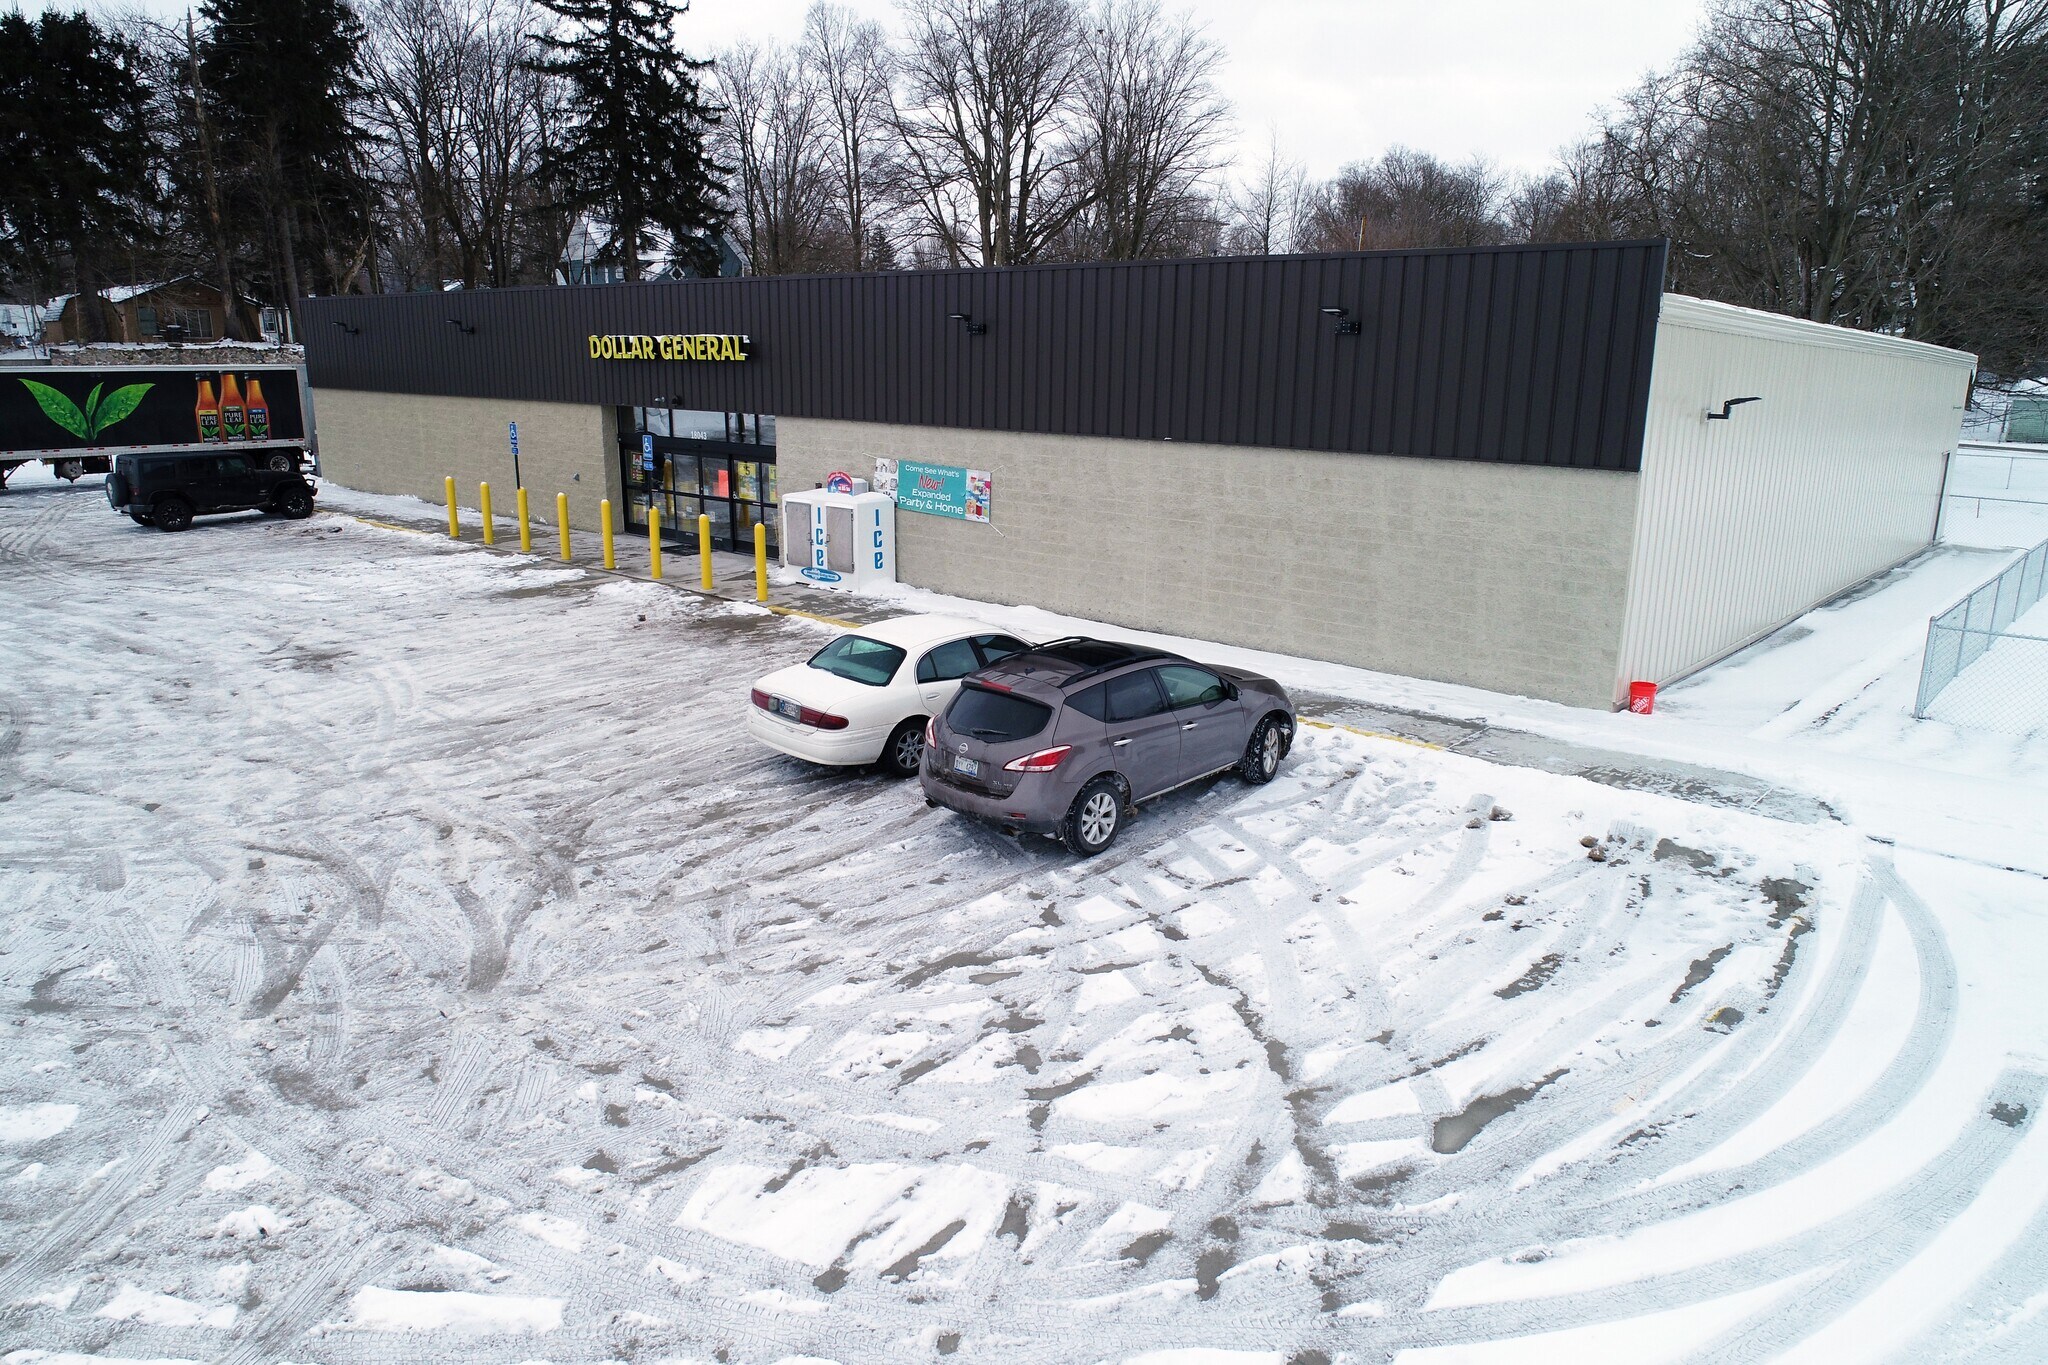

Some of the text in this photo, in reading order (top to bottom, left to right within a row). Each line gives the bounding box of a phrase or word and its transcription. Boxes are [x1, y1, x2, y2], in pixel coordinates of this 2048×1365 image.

[588, 335, 748, 361] DOLLAR GENERAL
[905, 464, 960, 478] Come See What's
[918, 474, 945, 491] New!
[912, 488, 951, 502] Expanded
[899, 496, 964, 515] Party & Home
[1631, 697, 1649, 711] HOME
